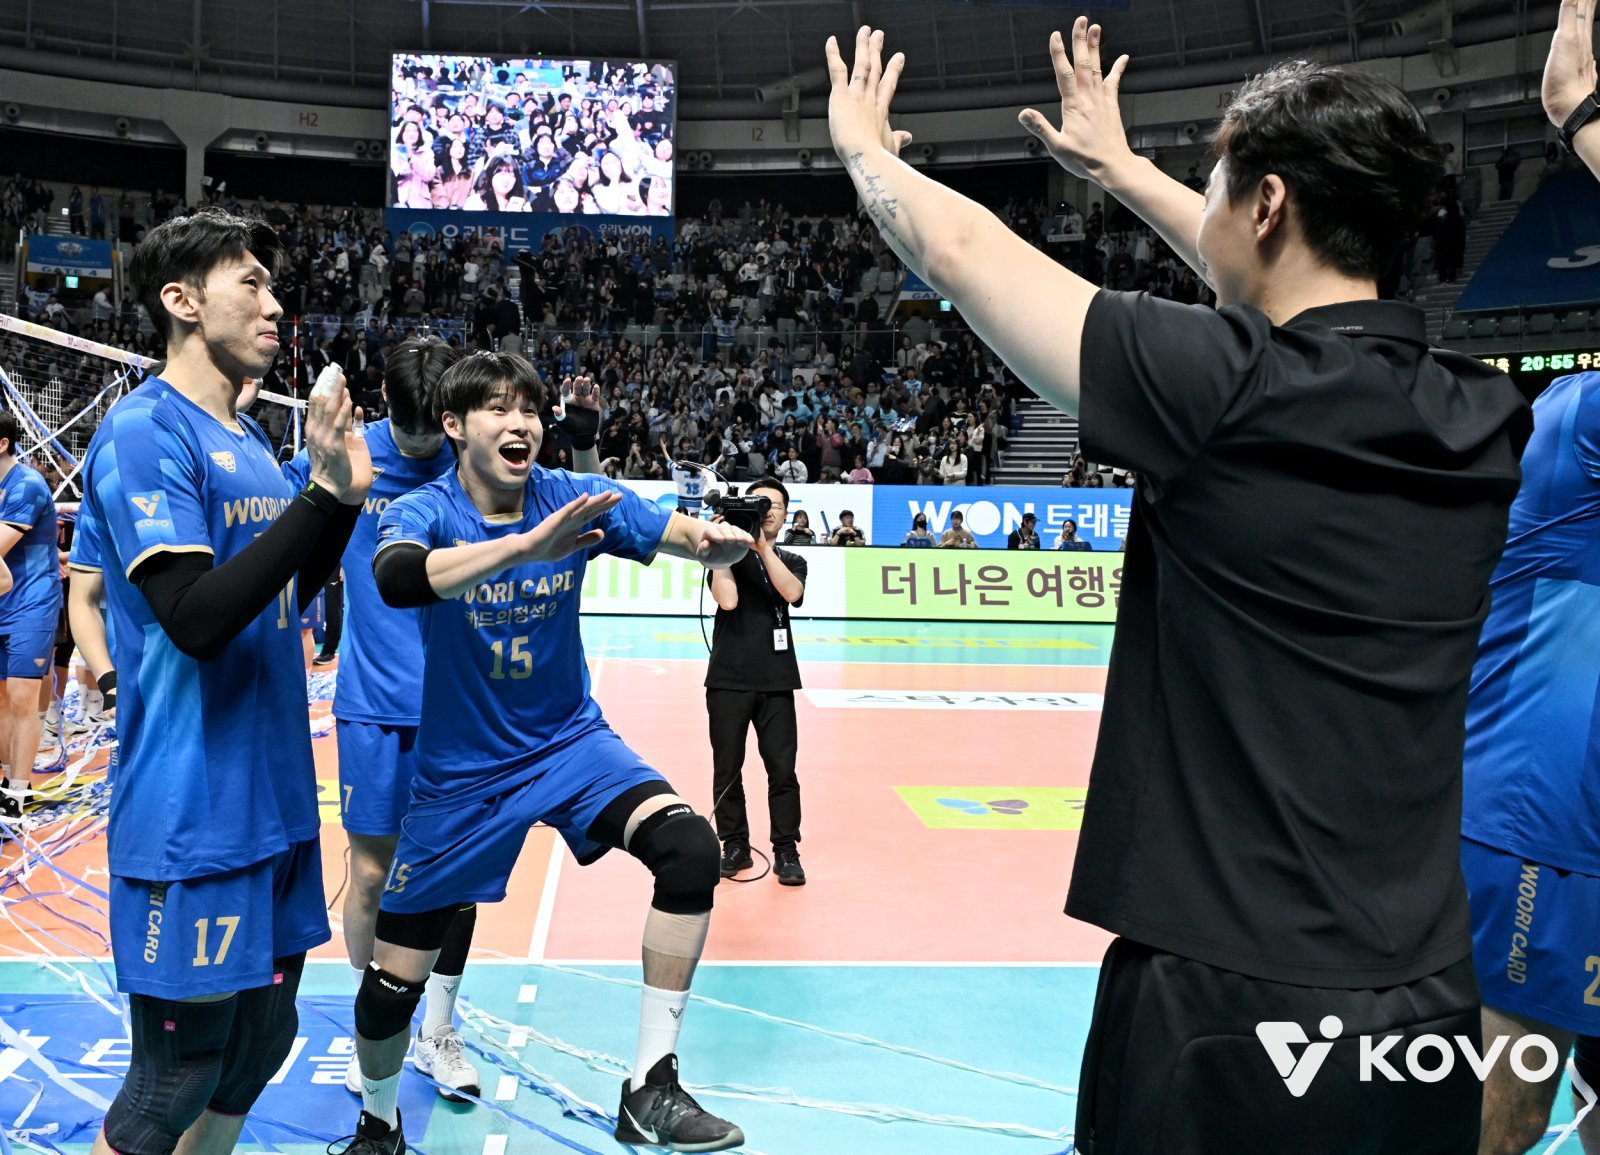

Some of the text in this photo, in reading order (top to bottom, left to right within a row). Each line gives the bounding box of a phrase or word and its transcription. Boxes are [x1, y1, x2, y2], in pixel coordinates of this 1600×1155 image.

[299, 112, 318, 127] H2
[41, 265, 97, 277] GATE 4
[911, 292, 939, 300] GAT
[1520, 353, 1575, 372] 20:55
[519, 569, 575, 600] CARD
[881, 562, 917, 605] 더
[933, 563, 1013, 607] 나은
[489, 635, 533, 680] 15
[143, 909, 163, 964] CARD
[192, 915, 241, 967] 17
[1507, 863, 1540, 985] WOORI CARD
